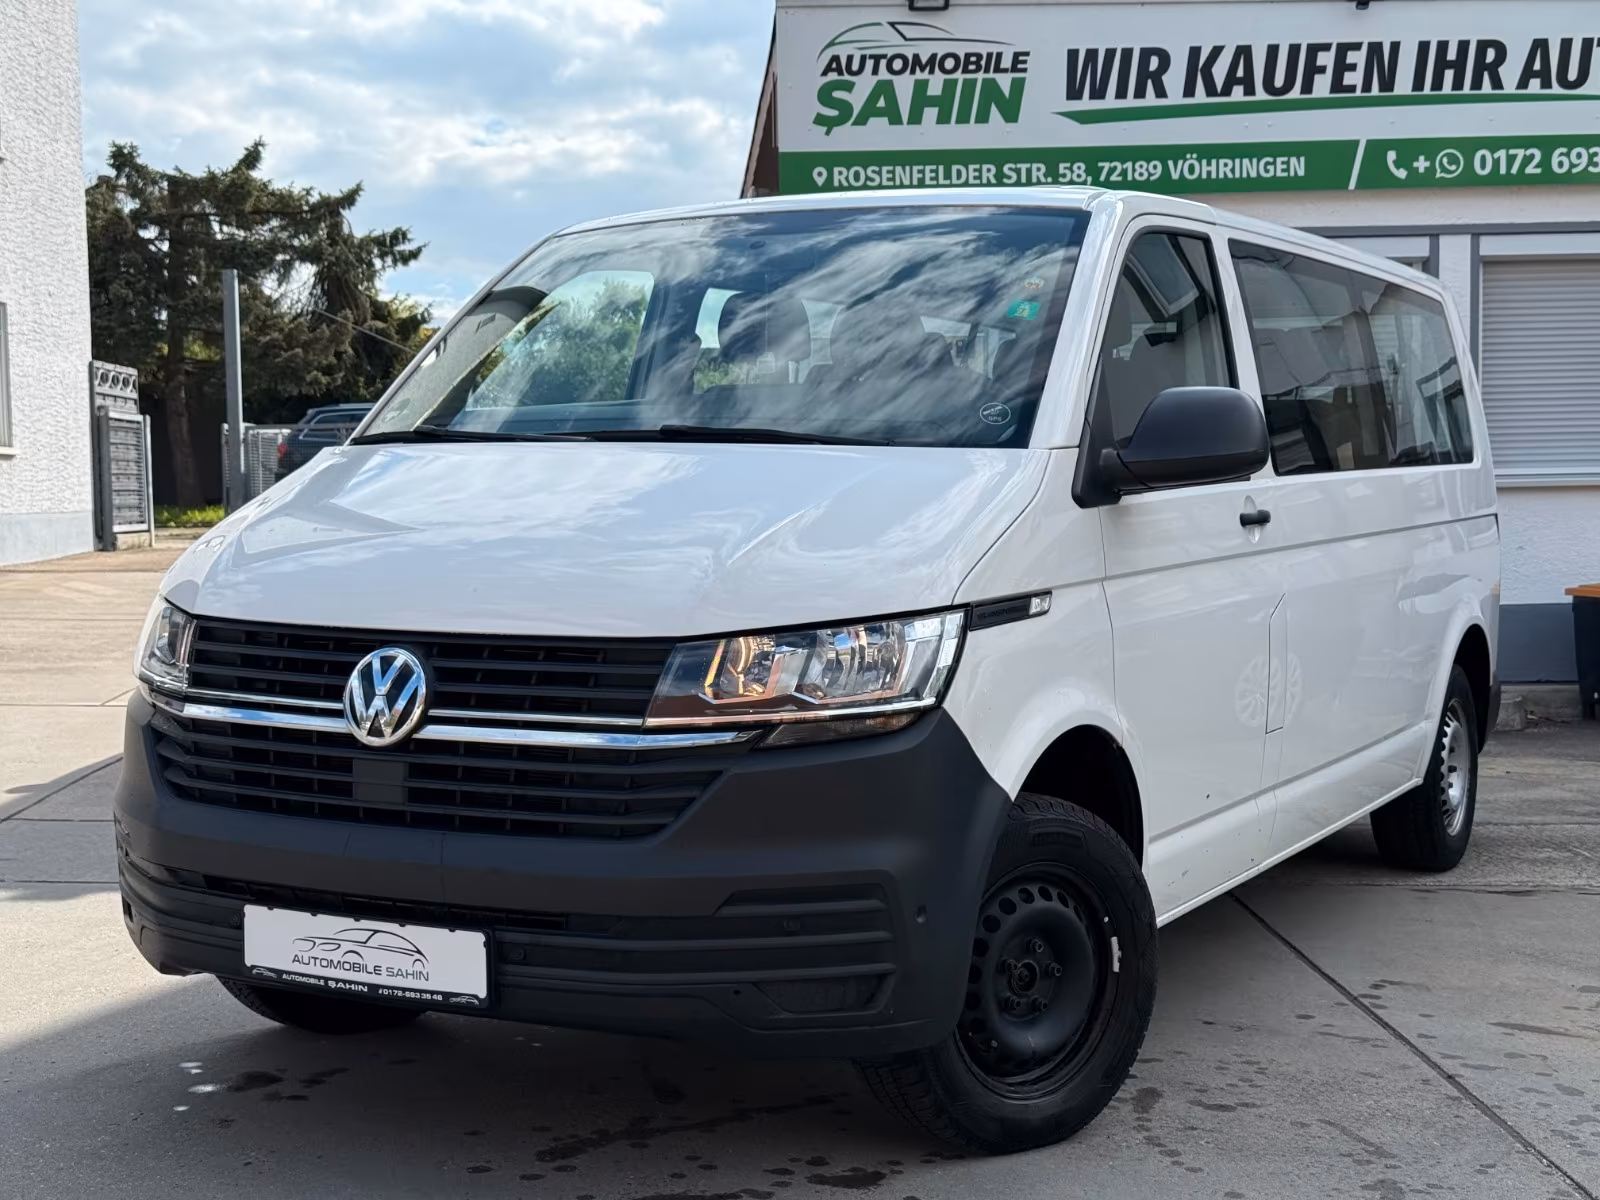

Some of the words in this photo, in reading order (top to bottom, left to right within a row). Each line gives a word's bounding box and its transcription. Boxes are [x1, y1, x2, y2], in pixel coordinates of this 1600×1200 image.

[820, 51, 1030, 77] AUTOMOBILE
[1065, 46, 1171, 101] WIR
[1182, 40, 1401, 99] KAUFEN
[1411, 39, 1507, 93] IHR
[1515, 37, 1600, 90] AU
[812, 76, 1026, 136] ŞAHIN
[833, 164, 997, 187] ROSENFELDER
[1002, 162, 1052, 184] STR.
[1058, 162, 1092, 186] 58,
[1098, 160, 1162, 183] 72189
[1167, 153, 1305, 180] VÖHRINGEN
[1473, 148, 1542, 176] 0172
[282, 973, 325, 986] AUTOMOBILE
[292, 954, 382, 976] AUTOMOBILE
[386, 967, 429, 982] SAHIN
